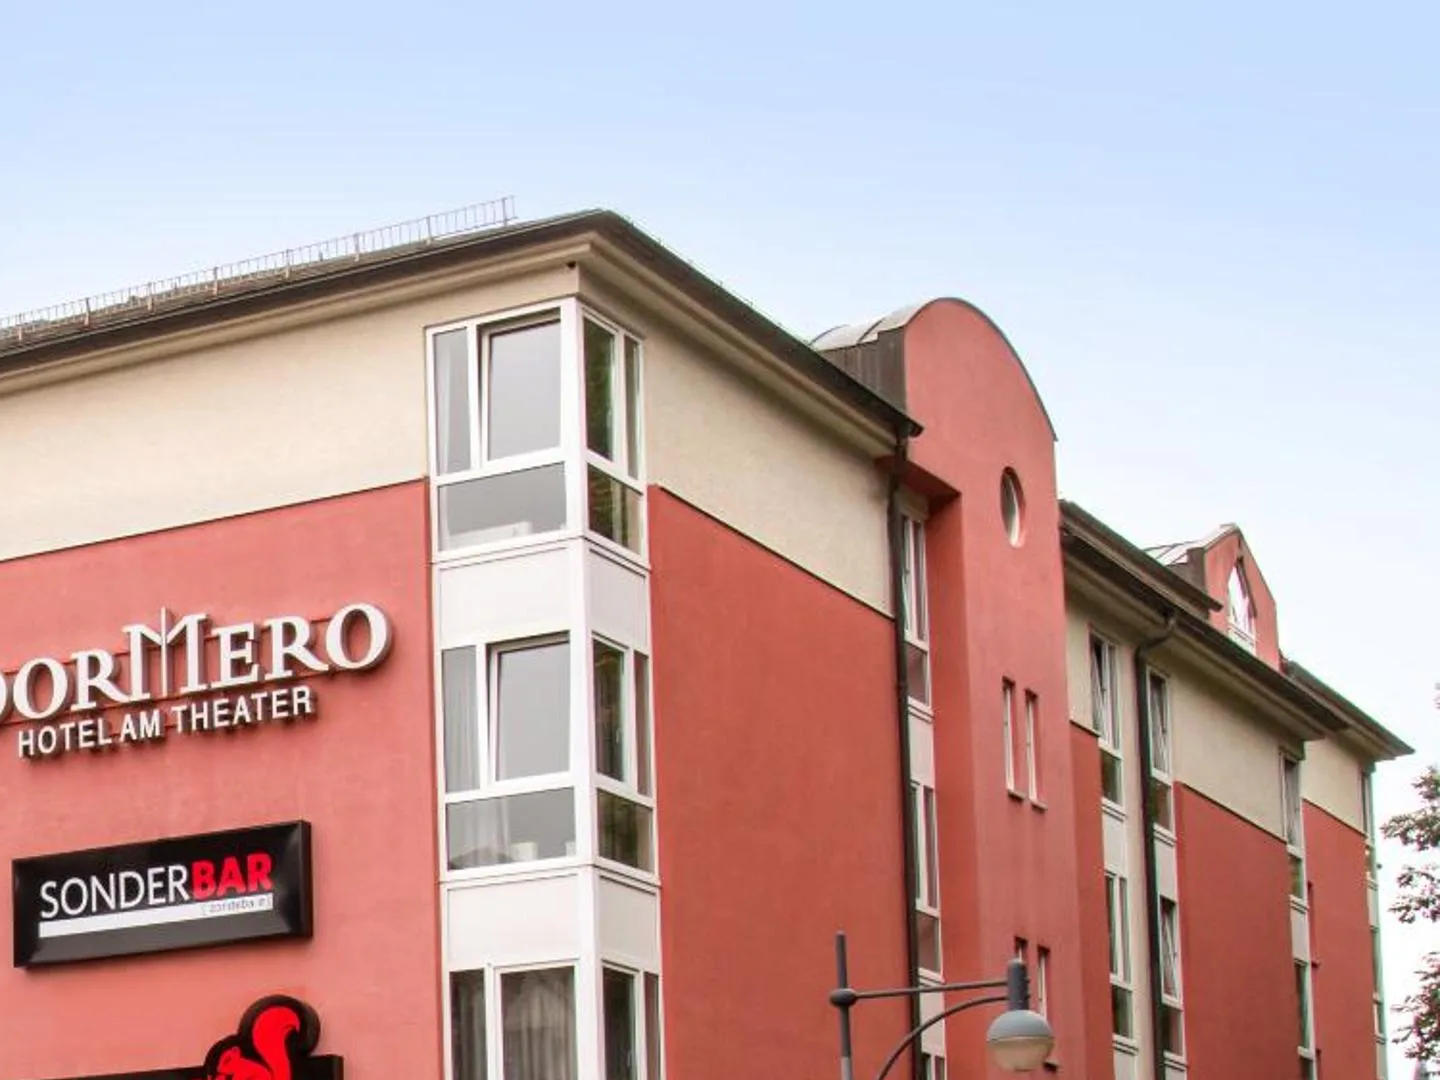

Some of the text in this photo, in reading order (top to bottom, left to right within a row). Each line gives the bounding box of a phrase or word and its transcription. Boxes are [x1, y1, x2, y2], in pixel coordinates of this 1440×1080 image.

[18, 685, 314, 758] HOTEL AM THEATER
[39, 852, 274, 918] SONDERBAR
